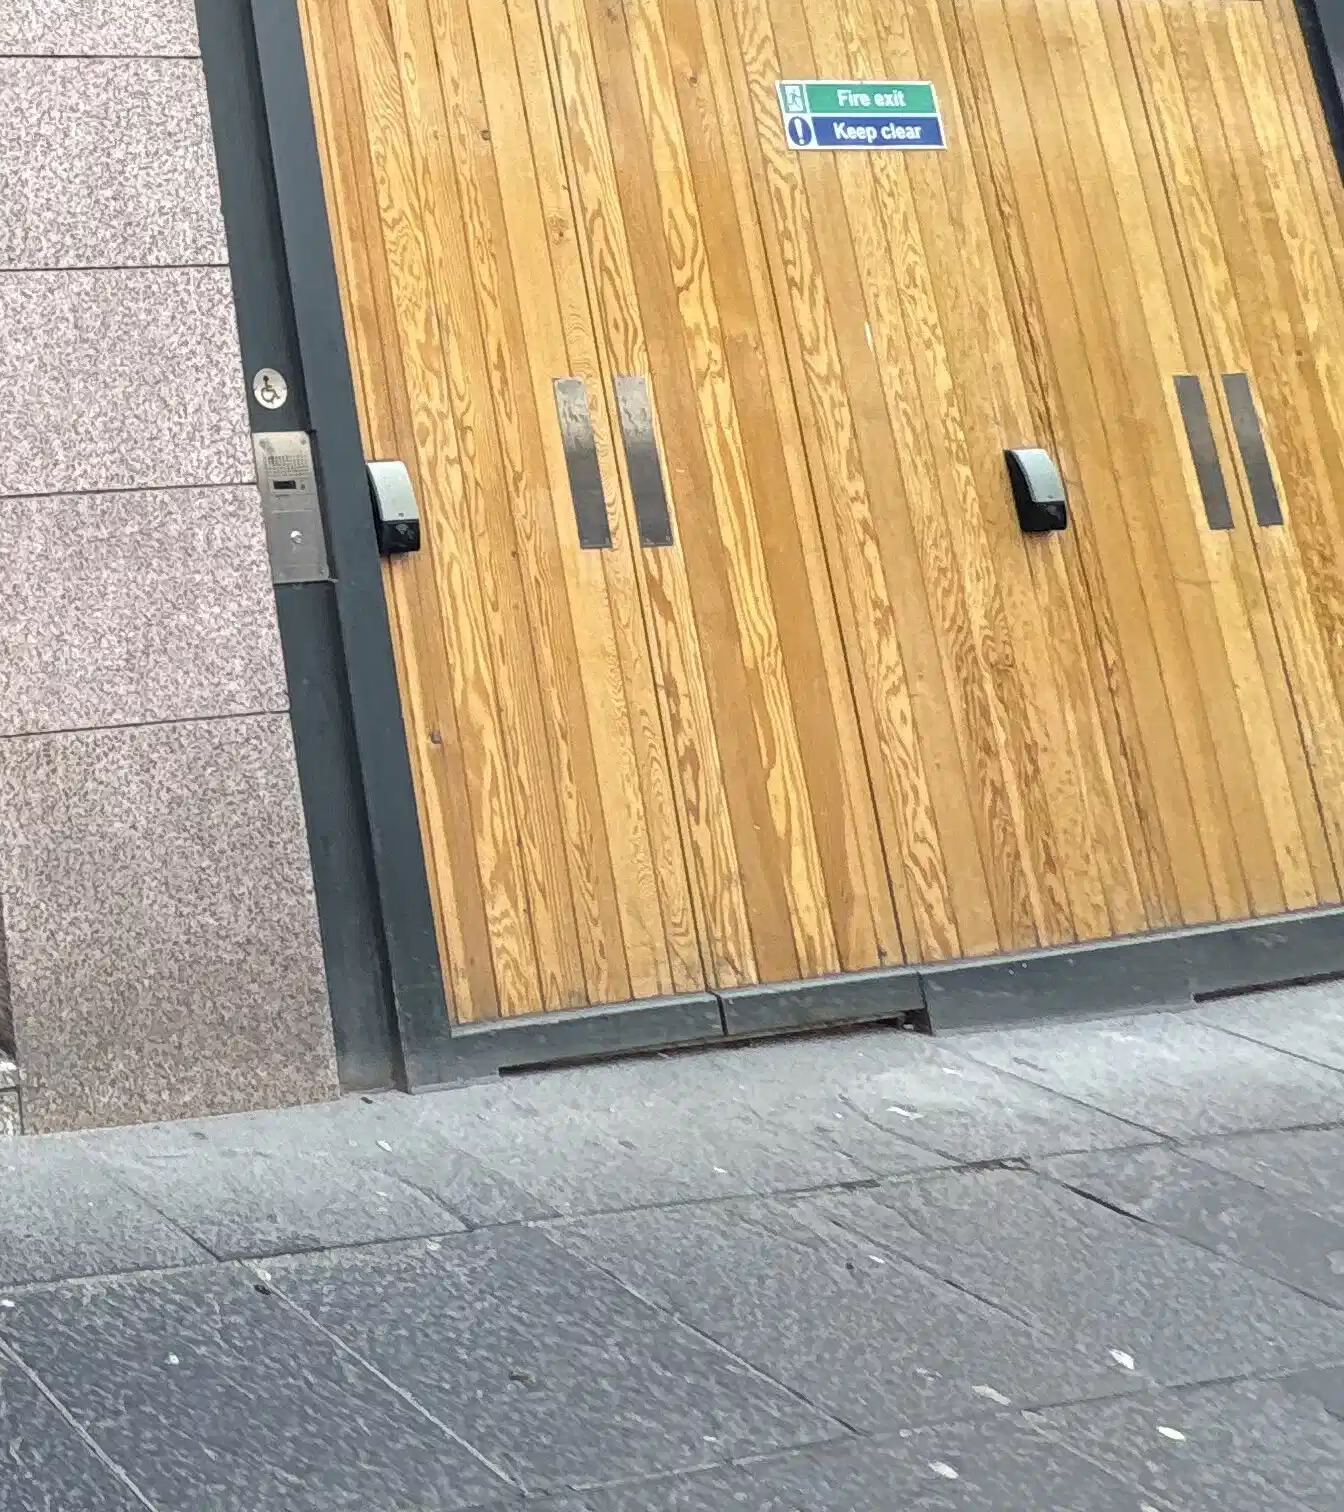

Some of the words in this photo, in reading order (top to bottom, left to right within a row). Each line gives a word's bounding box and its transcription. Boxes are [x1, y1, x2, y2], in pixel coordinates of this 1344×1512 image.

[837, 89, 872, 107] Fire
[874, 89, 907, 107] exit
[832, 122, 878, 144] Keep
[880, 122, 922, 140] clear
